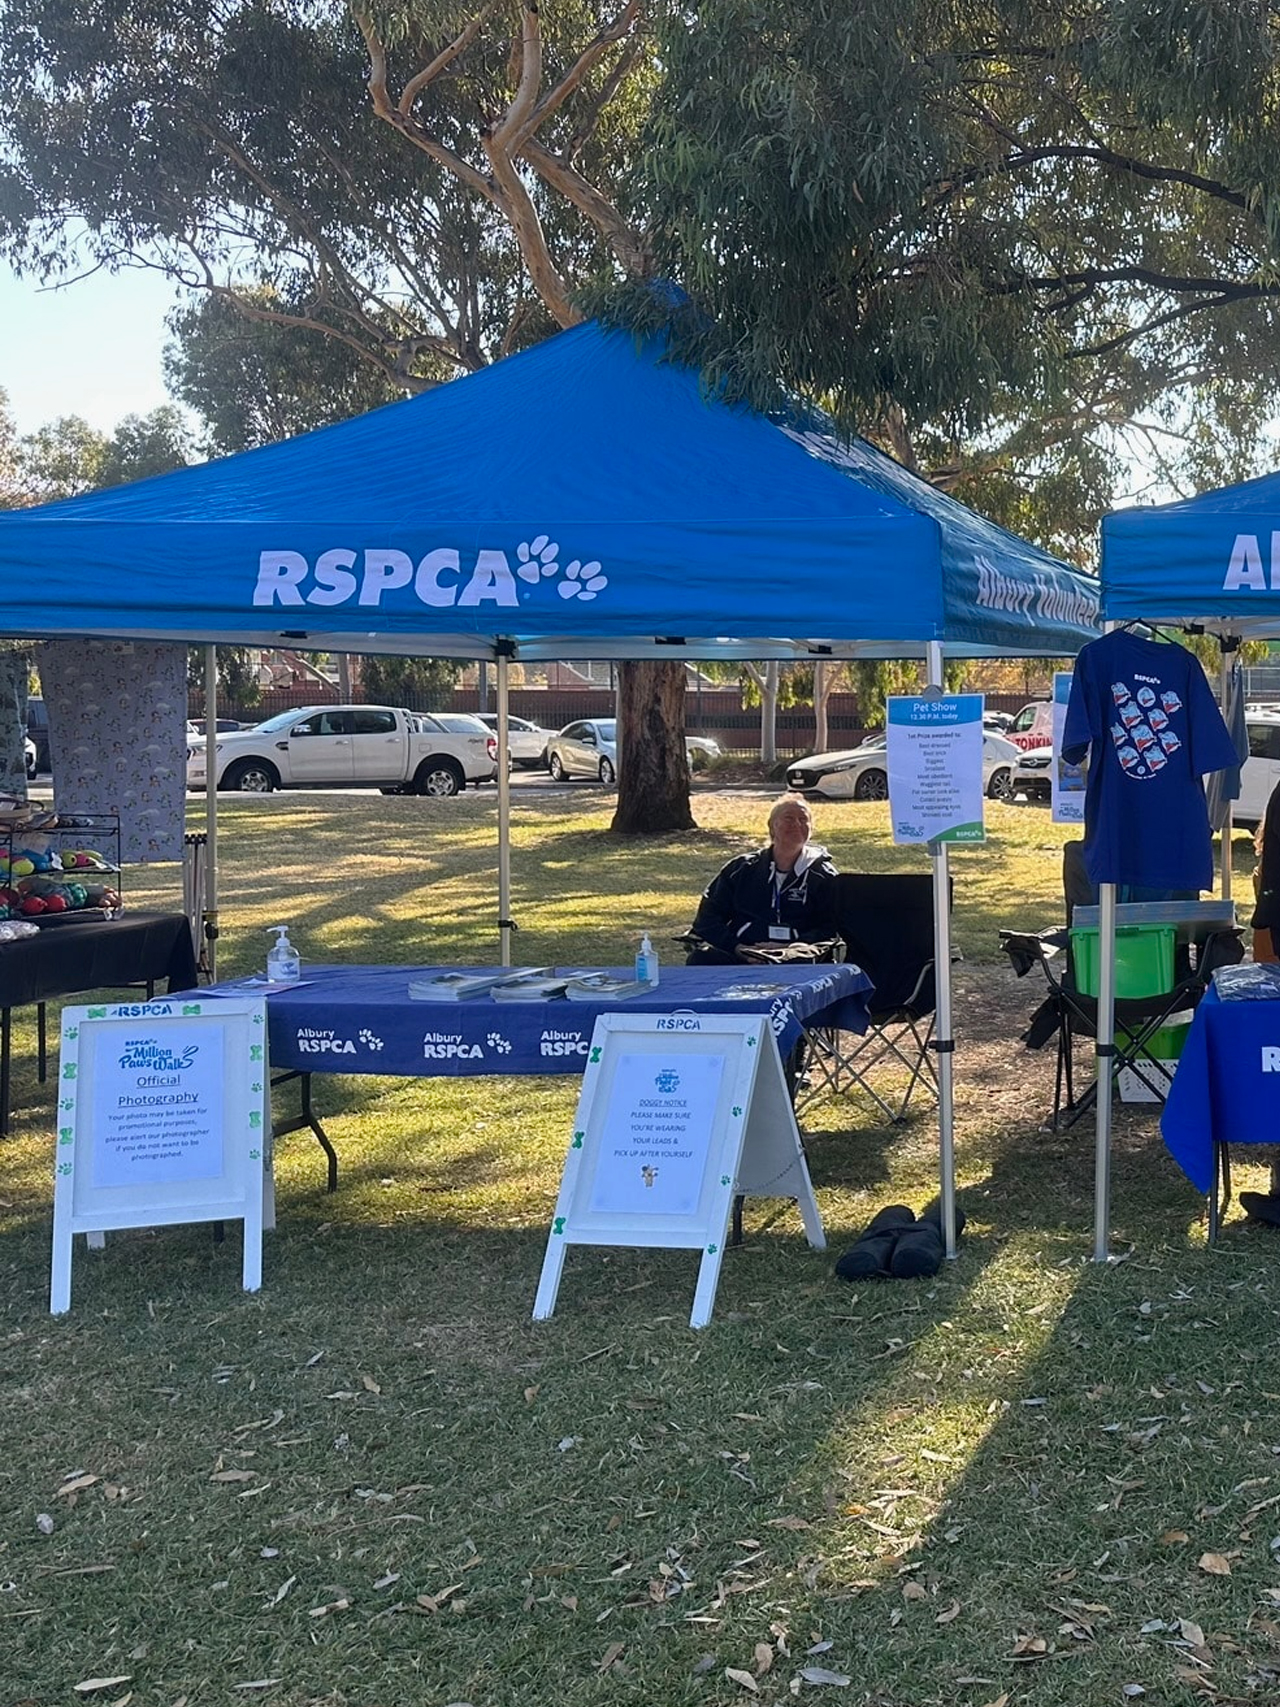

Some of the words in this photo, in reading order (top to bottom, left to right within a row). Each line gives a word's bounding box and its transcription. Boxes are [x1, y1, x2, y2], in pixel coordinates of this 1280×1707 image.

[253, 549, 519, 606] RSPCA
[974, 555, 1036, 627] Albury
[913, 703, 929, 712] Pet
[931, 702, 957, 712] Show
[118, 1004, 172, 1017] RSPCA
[656, 1019, 700, 1030] RSPCA
[297, 1028, 335, 1040] Albury
[424, 1032, 462, 1044] Albury
[541, 1030, 582, 1042] Albury
[125, 1046, 172, 1059] Million
[299, 1039, 356, 1054] RSPCA
[424, 1044, 484, 1059] RSPCA
[540, 1042, 589, 1056] RSPC
[118, 1055, 152, 1069] Paws
[137, 1073, 180, 1087] Official
[118, 1091, 199, 1106] Photography
